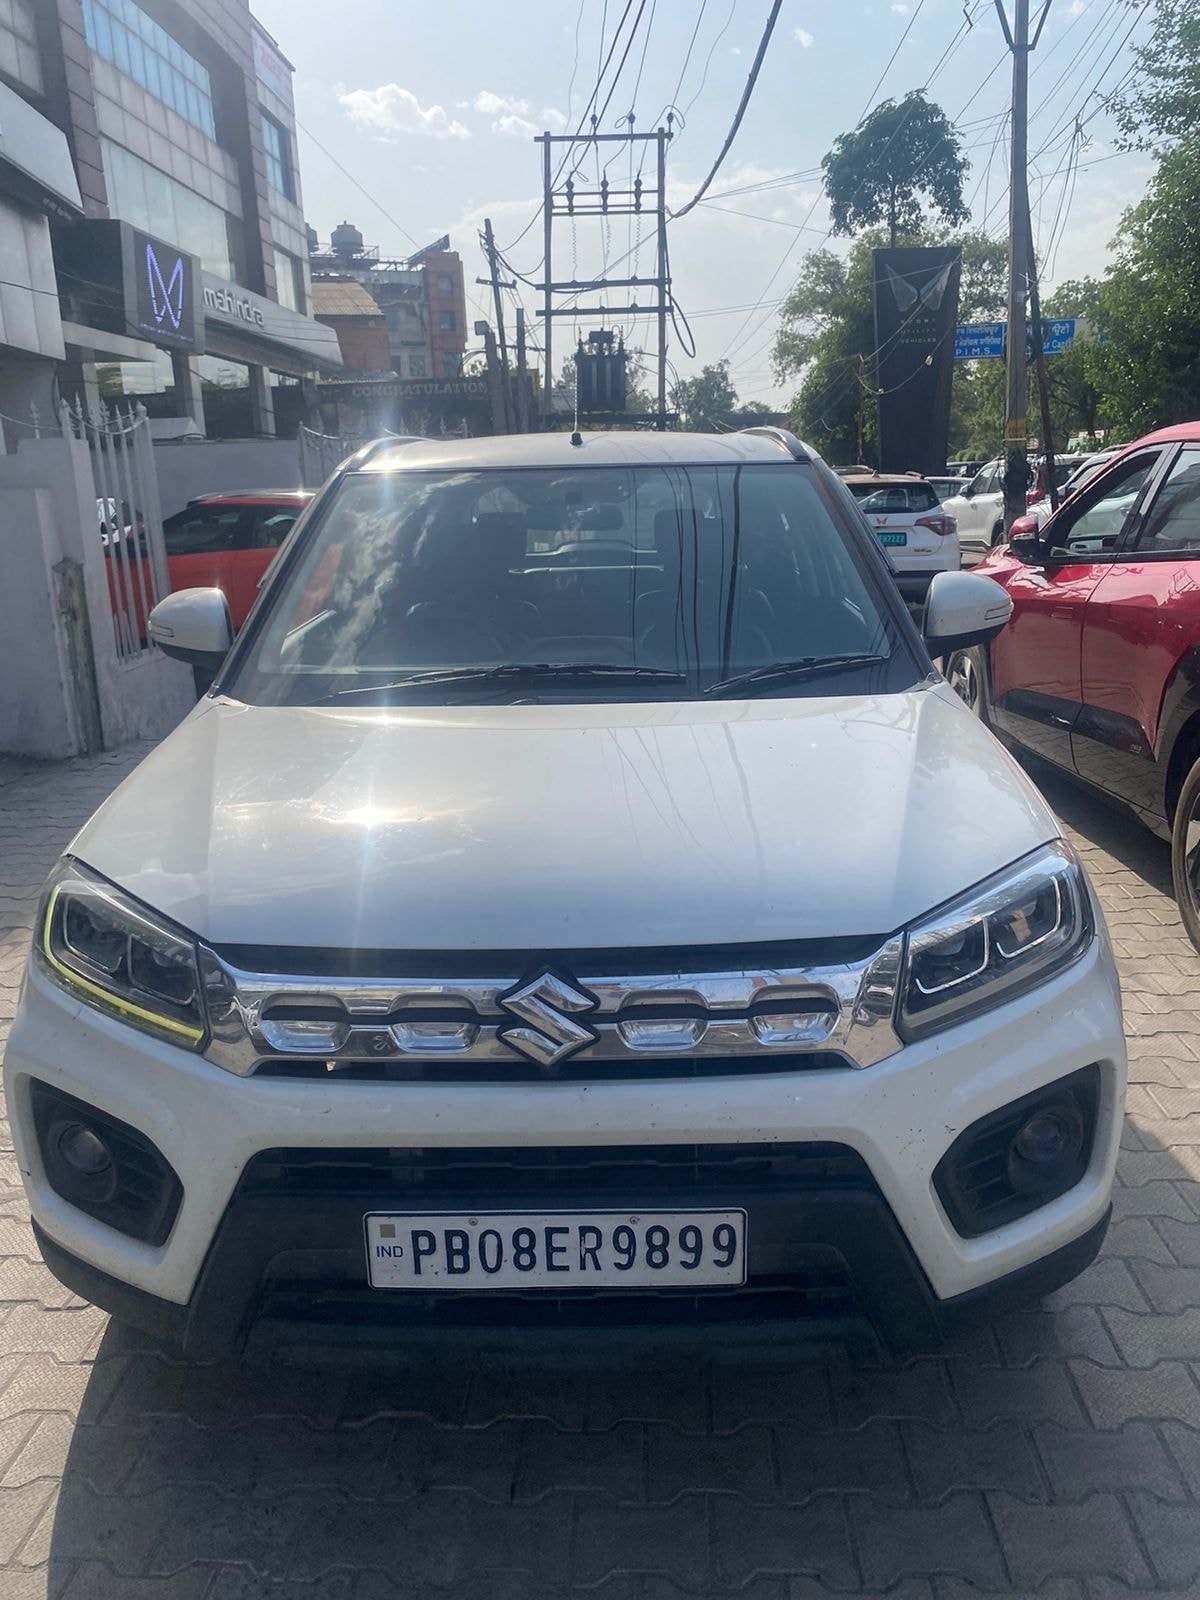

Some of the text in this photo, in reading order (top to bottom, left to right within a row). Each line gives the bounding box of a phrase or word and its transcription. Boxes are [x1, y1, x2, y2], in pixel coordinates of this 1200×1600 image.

[203, 287, 265, 327] mahindra
[376, 1245, 404, 1258] IND
[411, 1223, 737, 1275] PB08ER9899
